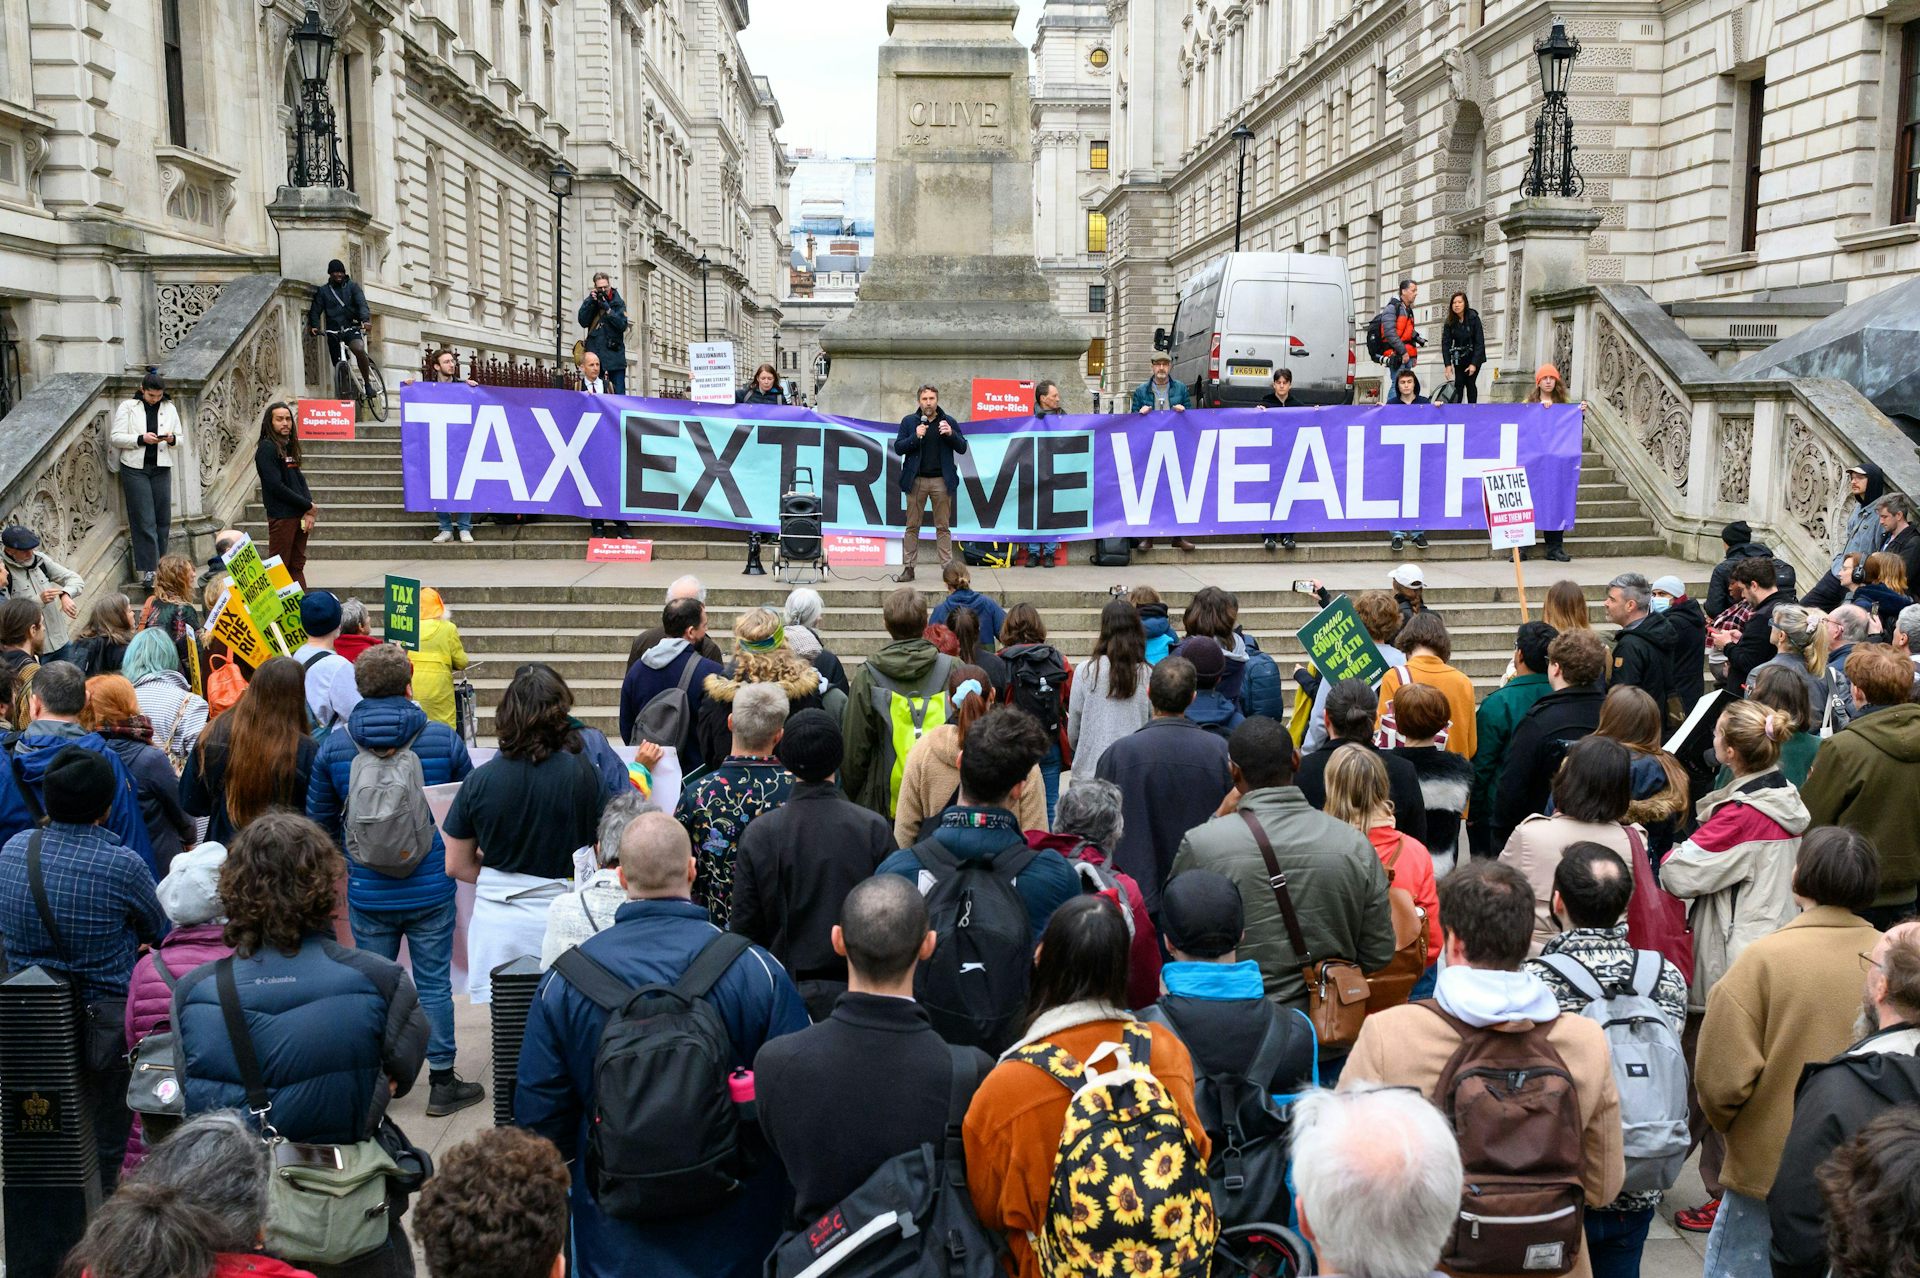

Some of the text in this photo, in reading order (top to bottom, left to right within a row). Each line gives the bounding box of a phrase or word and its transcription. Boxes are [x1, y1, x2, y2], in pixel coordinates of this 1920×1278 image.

[909, 102, 998, 127] CLIVE
[902, 134, 1005, 146] 1725 1774
[977, 402, 1028, 412] Super-Rich
[985, 393, 1020, 402] Tax the
[303, 418, 350, 426] Super-Rich
[404, 402, 602, 507] TAX
[1110, 423, 1518, 526] WEALTH
[1486, 473, 1526, 491] TAX THE
[1498, 491, 1523, 508] RICH
[1494, 511, 1532, 524] MAKE THEM PAY
[229, 545, 255, 577] WELFARE
[236, 571, 250, 591] NOT
[243, 573, 270, 605] WARFARE
[391, 584, 413, 604] TAX
[396, 605, 408, 614] THE
[214, 607, 238, 636] TAX
[226, 617, 249, 646] THE
[391, 614, 413, 632] RICH
[1313, 610, 1343, 645] DEMAND
[238, 628, 256, 656] RIC
[1311, 615, 1354, 657] EQUALITY
[1335, 636, 1343, 651] OF
[1325, 634, 1364, 670] WEALTH
[1338, 652, 1372, 680] POWER
[263, 976, 296, 984] Columbia
